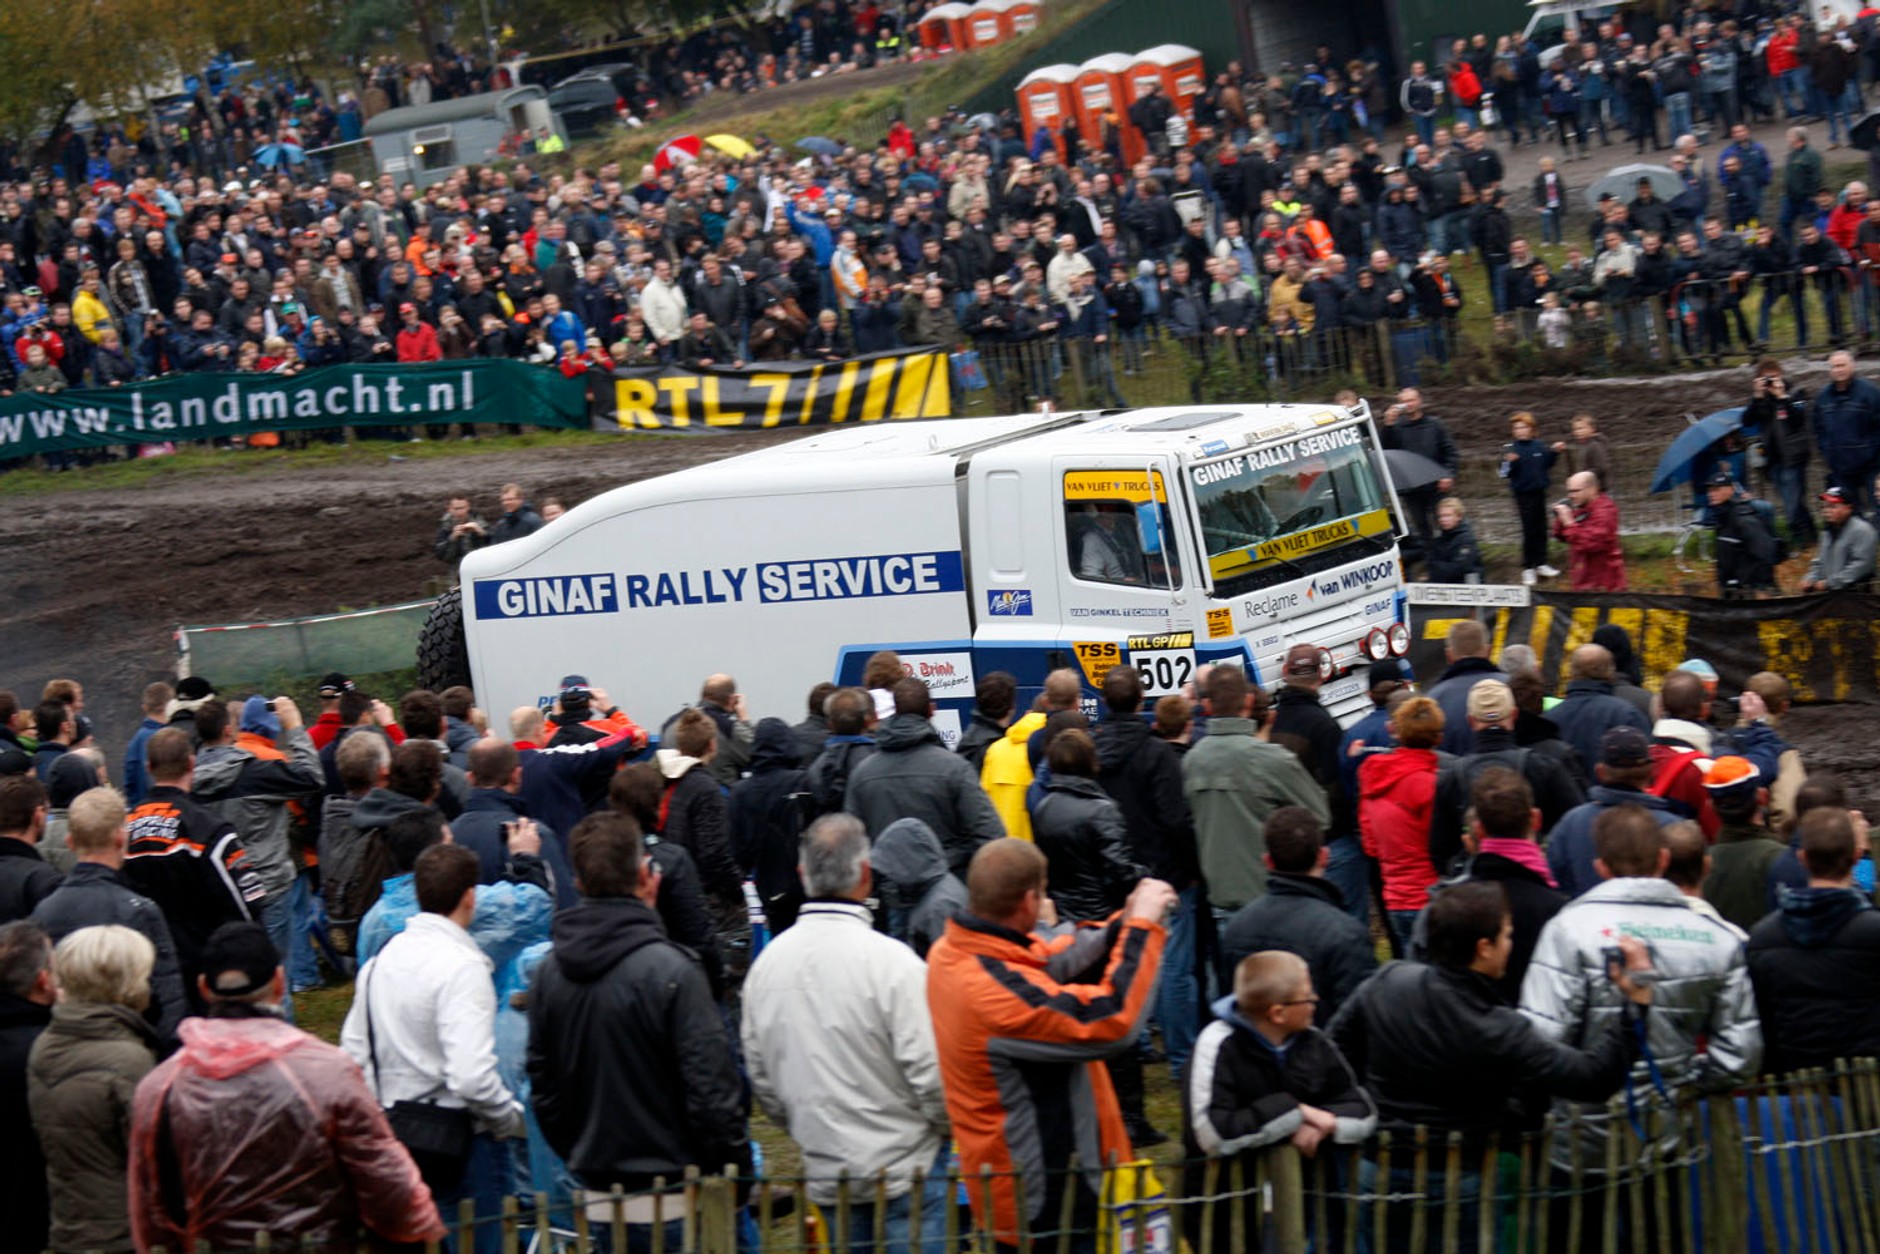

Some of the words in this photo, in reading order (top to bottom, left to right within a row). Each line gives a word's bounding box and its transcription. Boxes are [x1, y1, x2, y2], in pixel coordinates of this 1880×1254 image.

[1193, 458, 1244, 486] GINAF
[1247, 443, 1296, 472] RALLY
[1298, 426, 1361, 458] SERVICE
[1066, 482, 1084, 491] VAN
[1087, 482, 1111, 491] VLIET
[1261, 543, 1282, 557] VAN
[1283, 533, 1310, 551] VLIET
[1311, 522, 1349, 545] TRUCKS
[498, 577, 615, 616] GINAF
[628, 567, 748, 608] RALLY
[761, 553, 942, 601] SERVICE
[1319, 581, 1340, 596] van
[1340, 560, 1394, 590] WINKOOP
[1206, 609, 1230, 619] TSS
[1245, 593, 1298, 619] Reclame
[1365, 598, 1392, 616] GINAF
[1078, 643, 1117, 657] TSS
[1129, 637, 1150, 649] RTL
[1136, 655, 1192, 691] 502
